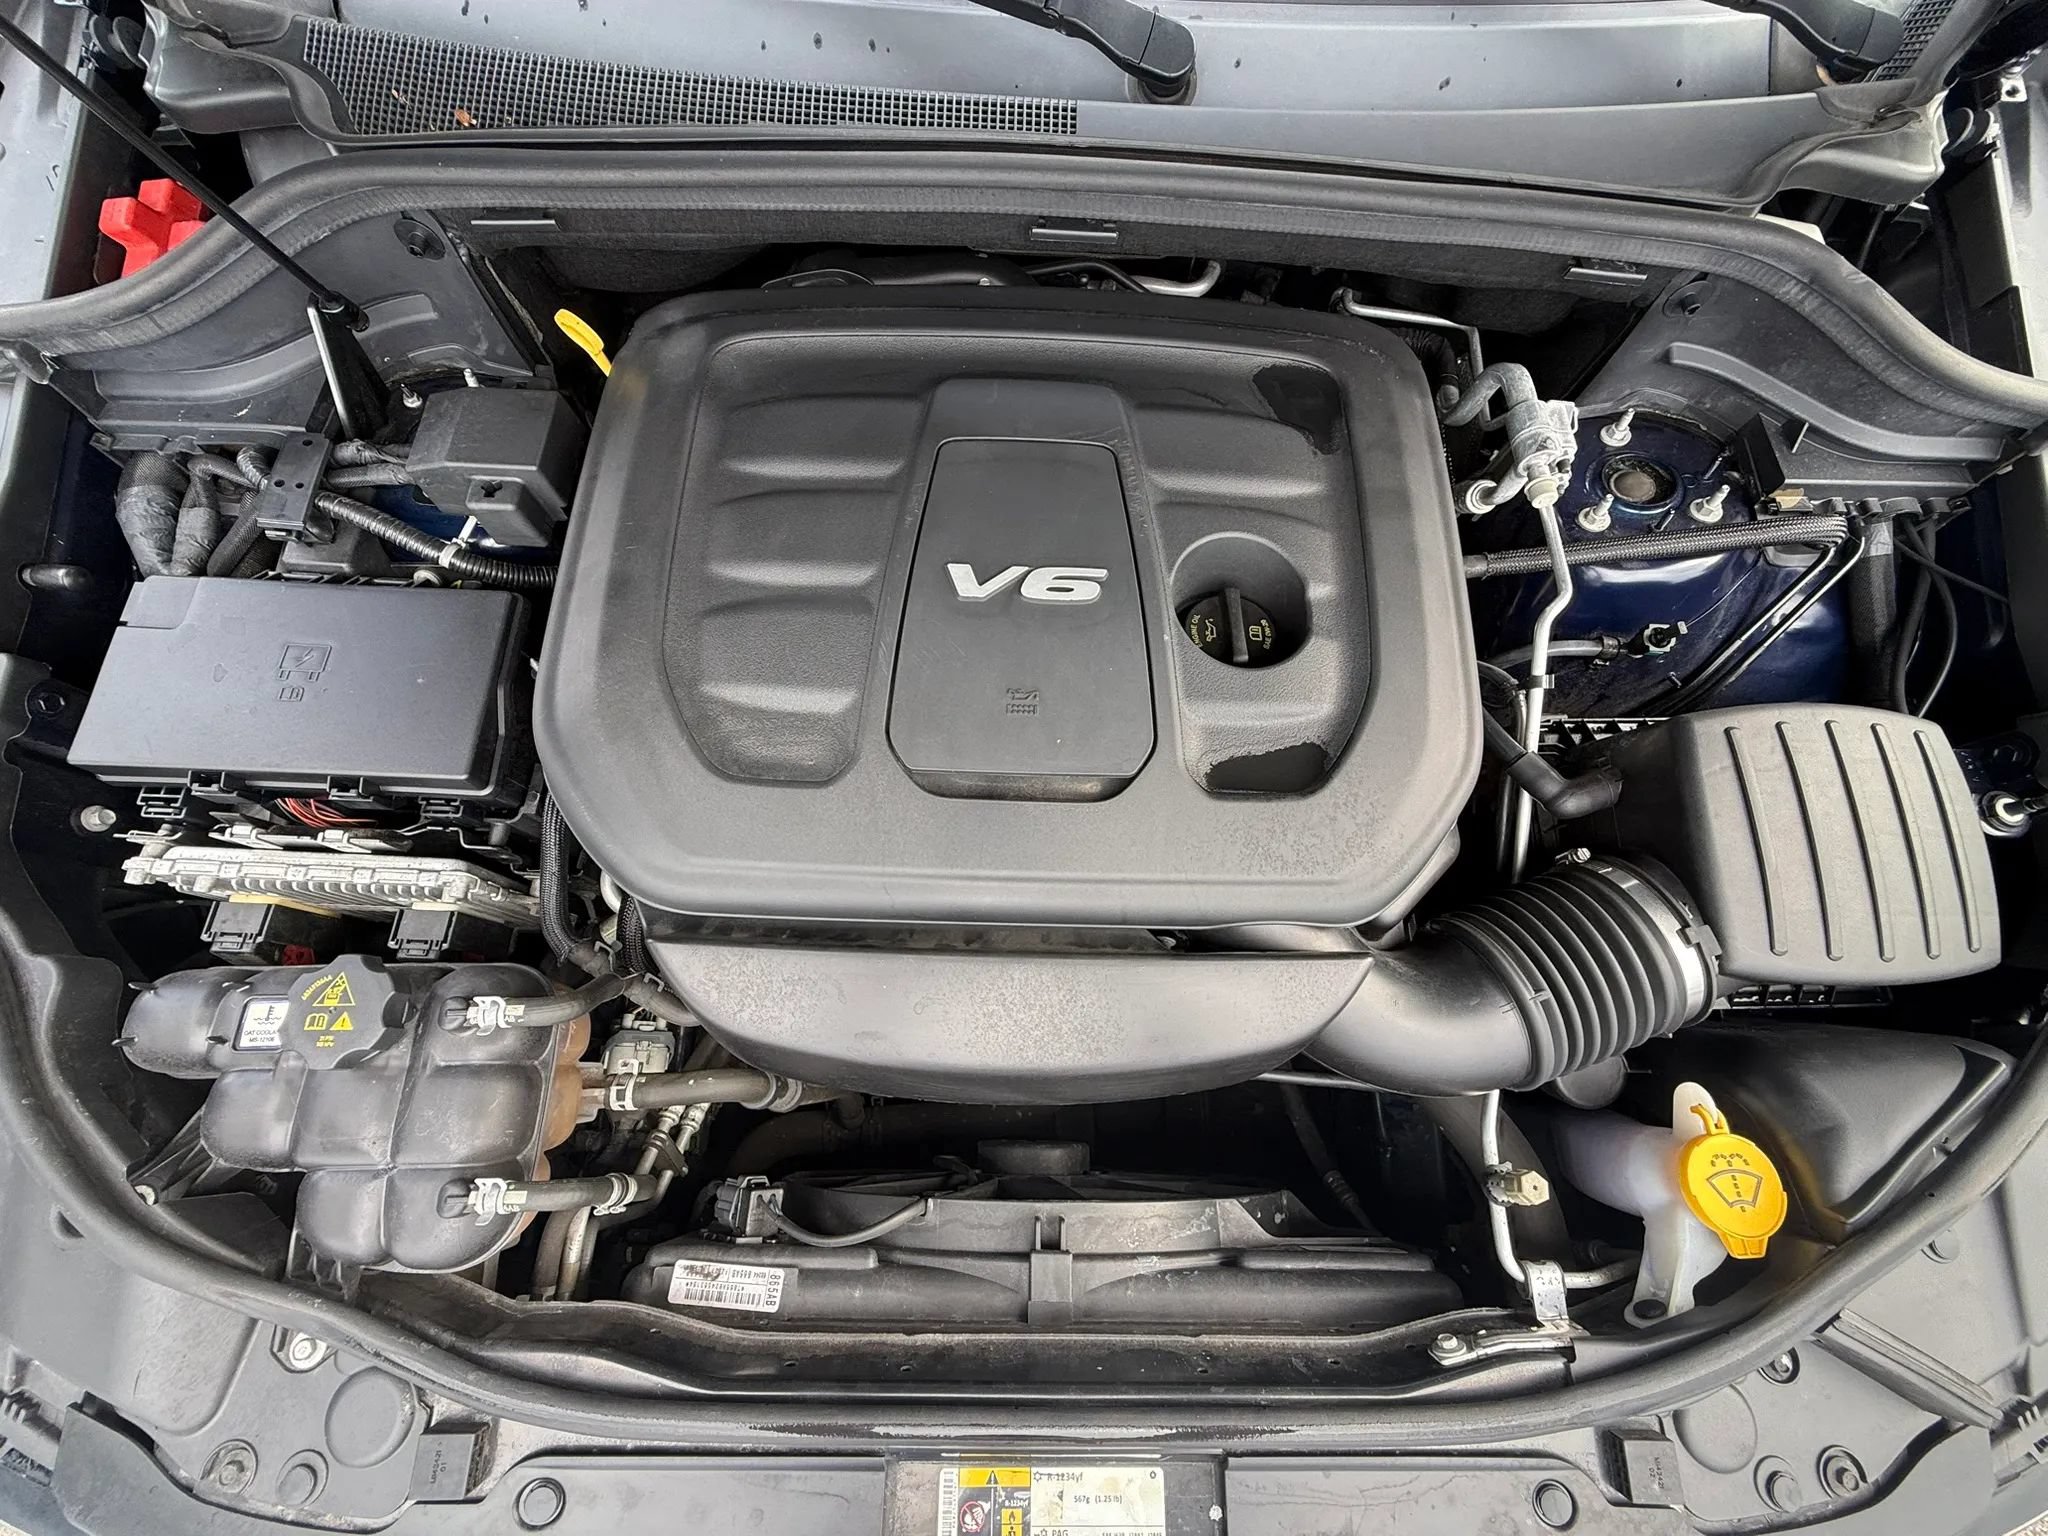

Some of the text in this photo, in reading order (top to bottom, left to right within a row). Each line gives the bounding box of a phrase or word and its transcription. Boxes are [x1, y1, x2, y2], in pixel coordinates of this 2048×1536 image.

[947, 563, 1109, 604] V6
[766, 1274, 781, 1307] 865AB
[1074, 1495, 1090, 1504] 567g
[1095, 1494, 1112, 1504] (1.25
